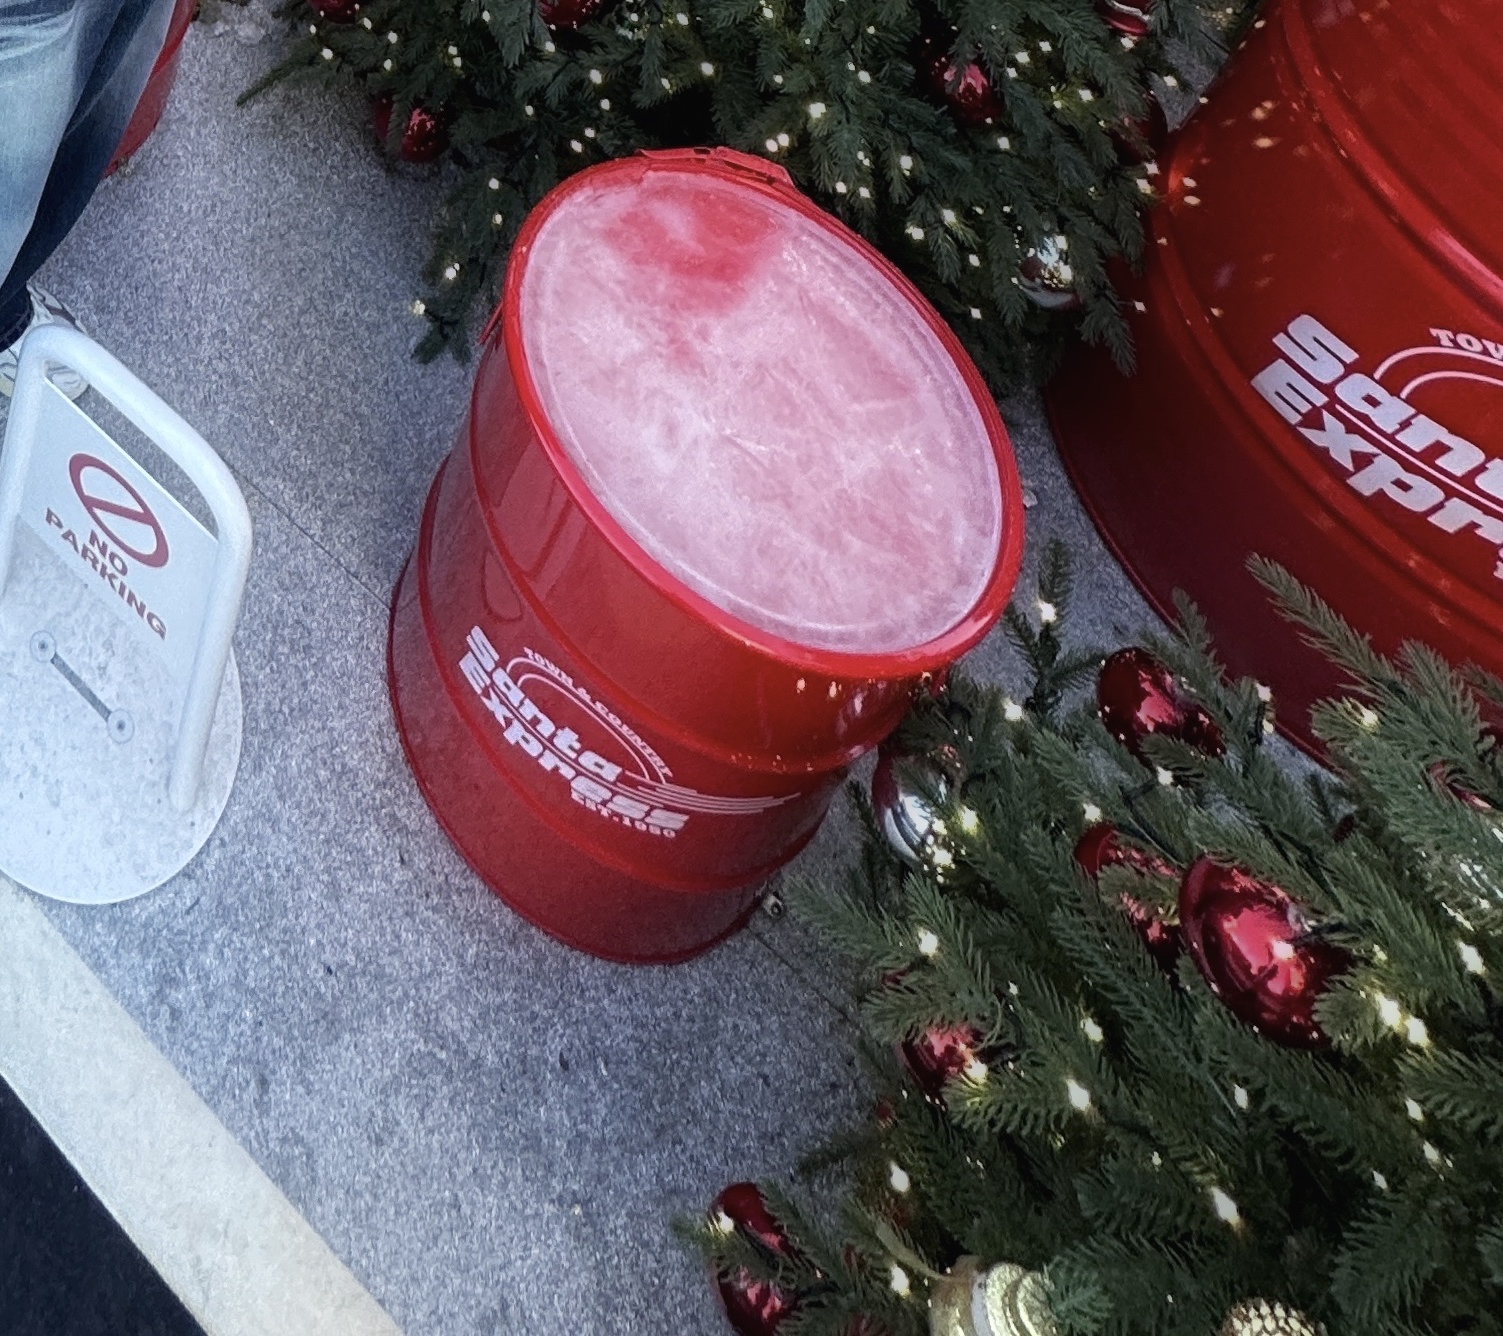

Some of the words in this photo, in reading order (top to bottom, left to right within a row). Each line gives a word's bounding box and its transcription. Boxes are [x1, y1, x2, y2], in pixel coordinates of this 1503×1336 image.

[45, 506, 168, 641] PARKING
[89, 529, 129, 577] NO
[458, 650, 690, 831] Express
[465, 625, 624, 783] Santa
